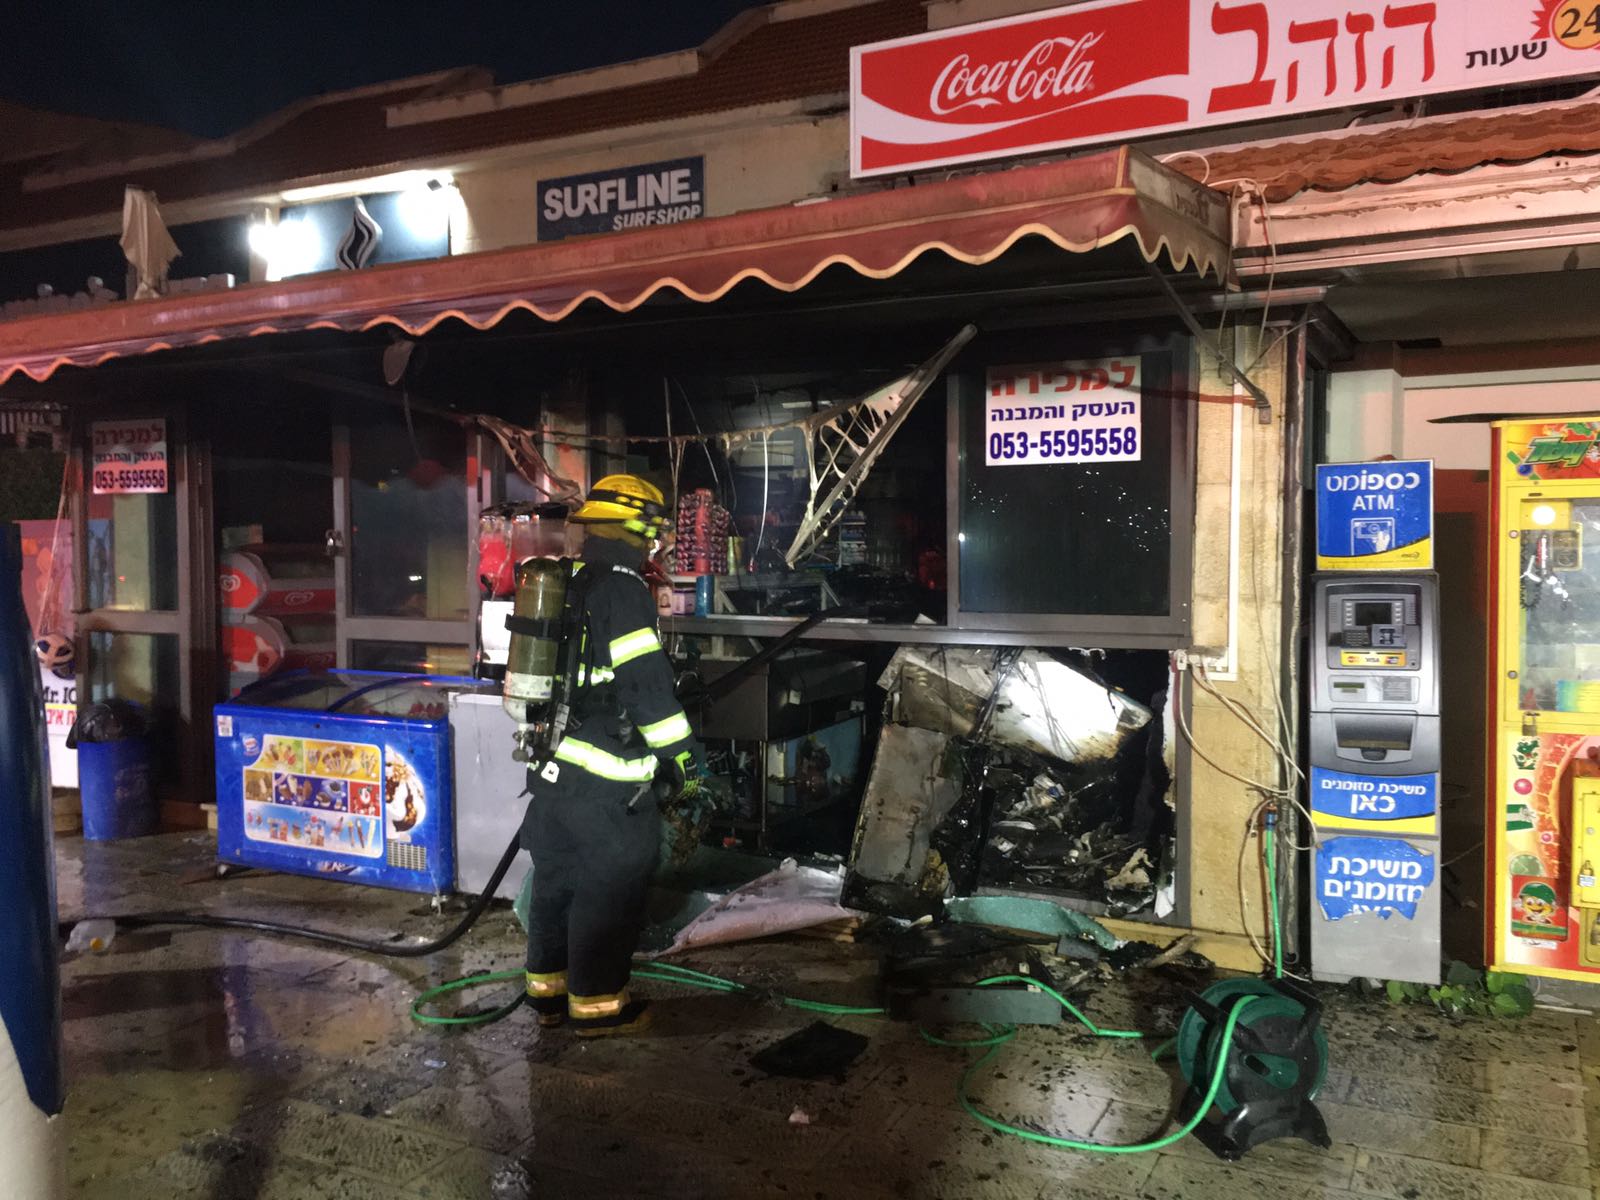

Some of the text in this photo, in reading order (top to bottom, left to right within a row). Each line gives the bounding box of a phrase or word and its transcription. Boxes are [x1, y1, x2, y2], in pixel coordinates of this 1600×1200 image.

[1560, 4, 1600, 39] 24
[1206, 0, 1436, 113] הזהב
[1466, 41, 1547, 68] שעות
[929, 30, 1105, 115] Coca-Cola
[612, 204, 702, 231] SURFSHOP
[991, 361, 1136, 397] למכירה
[991, 401, 1136, 421] העסק והמבנה
[990, 427, 1137, 459] 053-5595558
[95, 469, 165, 488] 053-5595558
[1352, 495, 1394, 511] ATM
[1321, 779, 1426, 795] משיכת מזומנים
[1351, 794, 1396, 814] כאן
[1328, 857, 1422, 880] משיכת
[1324, 879, 1425, 903] מזומנים
